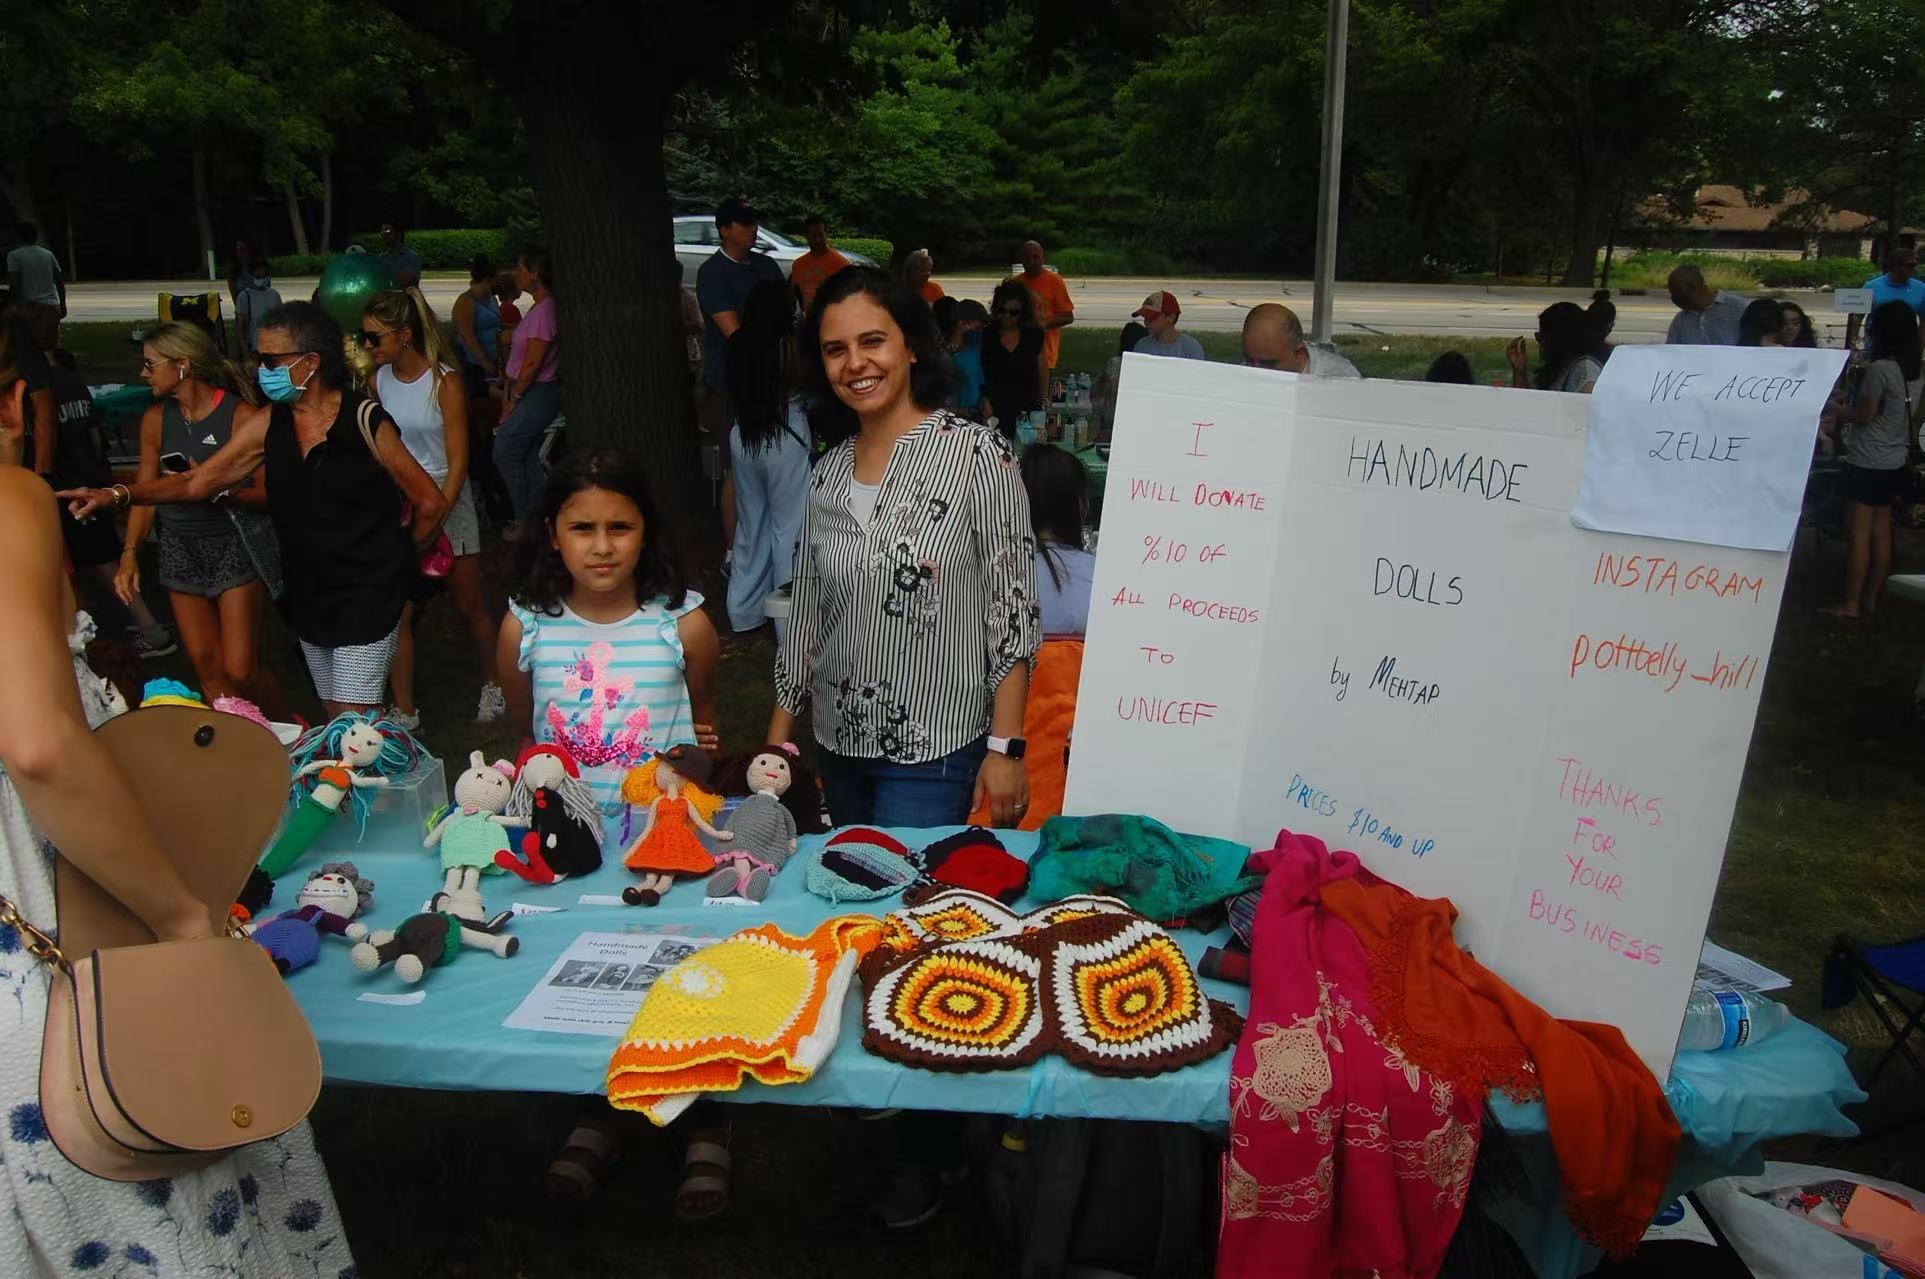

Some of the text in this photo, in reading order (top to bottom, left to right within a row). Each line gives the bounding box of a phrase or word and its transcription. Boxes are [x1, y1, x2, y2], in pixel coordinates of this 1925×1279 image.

[1650, 370, 1806, 403] WE ACCEPT
[58, 400, 92, 423] UMPIR
[1186, 423, 1214, 456] I
[1649, 431, 1750, 461] ZELLE
[1348, 436, 1528, 502] HANDMADE
[1132, 478, 1265, 511] WILL DONATE
[1142, 536, 1187, 565] %10
[1374, 558, 1462, 605] DOLLS
[1594, 552, 1763, 603] INSTAGRAM
[1112, 587, 1259, 623] ALL PROCEEDS
[1140, 647, 1174, 664] TO
[1331, 656, 1350, 701] by
[1118, 696, 1217, 726] UNICEF
[1556, 757, 1664, 826] THANKS
[1286, 774, 1434, 859] PRICES $10 AND UP
[1574, 818, 1616, 859] FOR
[1566, 854, 1624, 901] YOUR
[1529, 888, 1663, 965] BUSINESS
[587, 940, 649, 950] Handmade
[599, 949, 628, 957] Dolls
